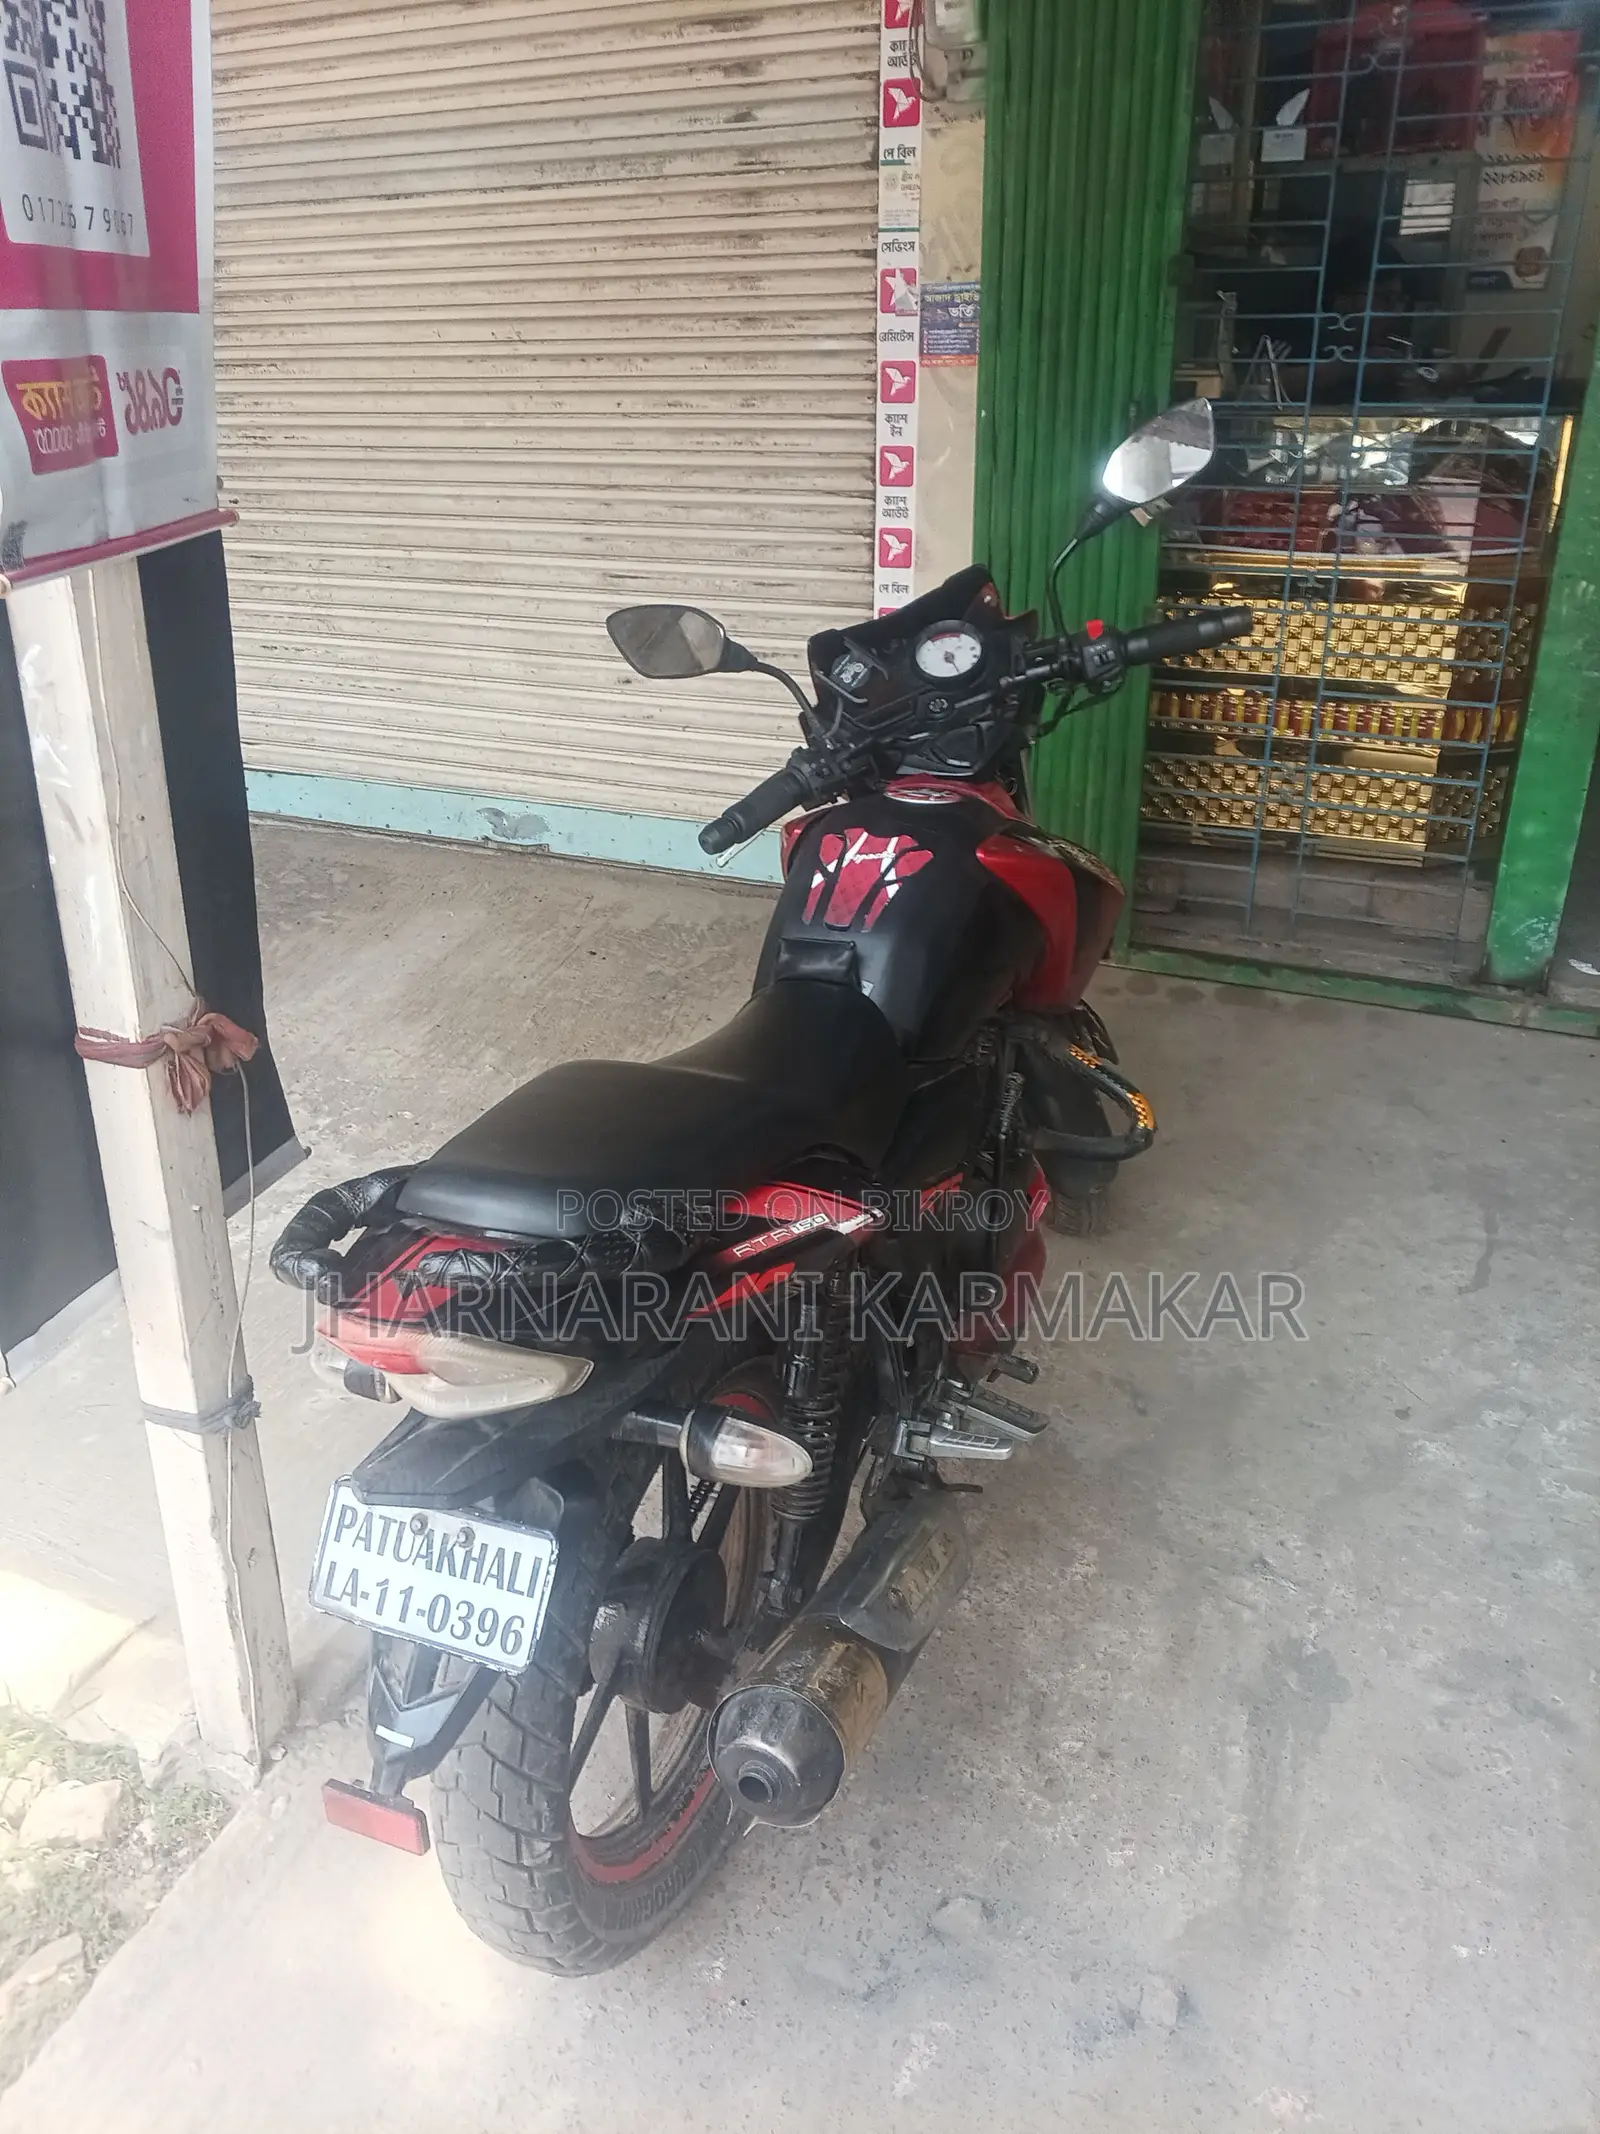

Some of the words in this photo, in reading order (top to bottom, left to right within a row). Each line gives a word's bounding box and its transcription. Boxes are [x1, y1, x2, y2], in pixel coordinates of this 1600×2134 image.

[897, 144, 916, 159] বিল
[881, 237, 916, 252] সেভিংস
[884, 413, 908, 425] ক্যাশ
[889, 425, 903, 437] ইন
[882, 506, 909, 519] আউট
[732, 1228, 792, 1258] RTR
[333, 1504, 543, 1598] PATUAKHALI
[322, 1561, 525, 1655] LA-11-0396
